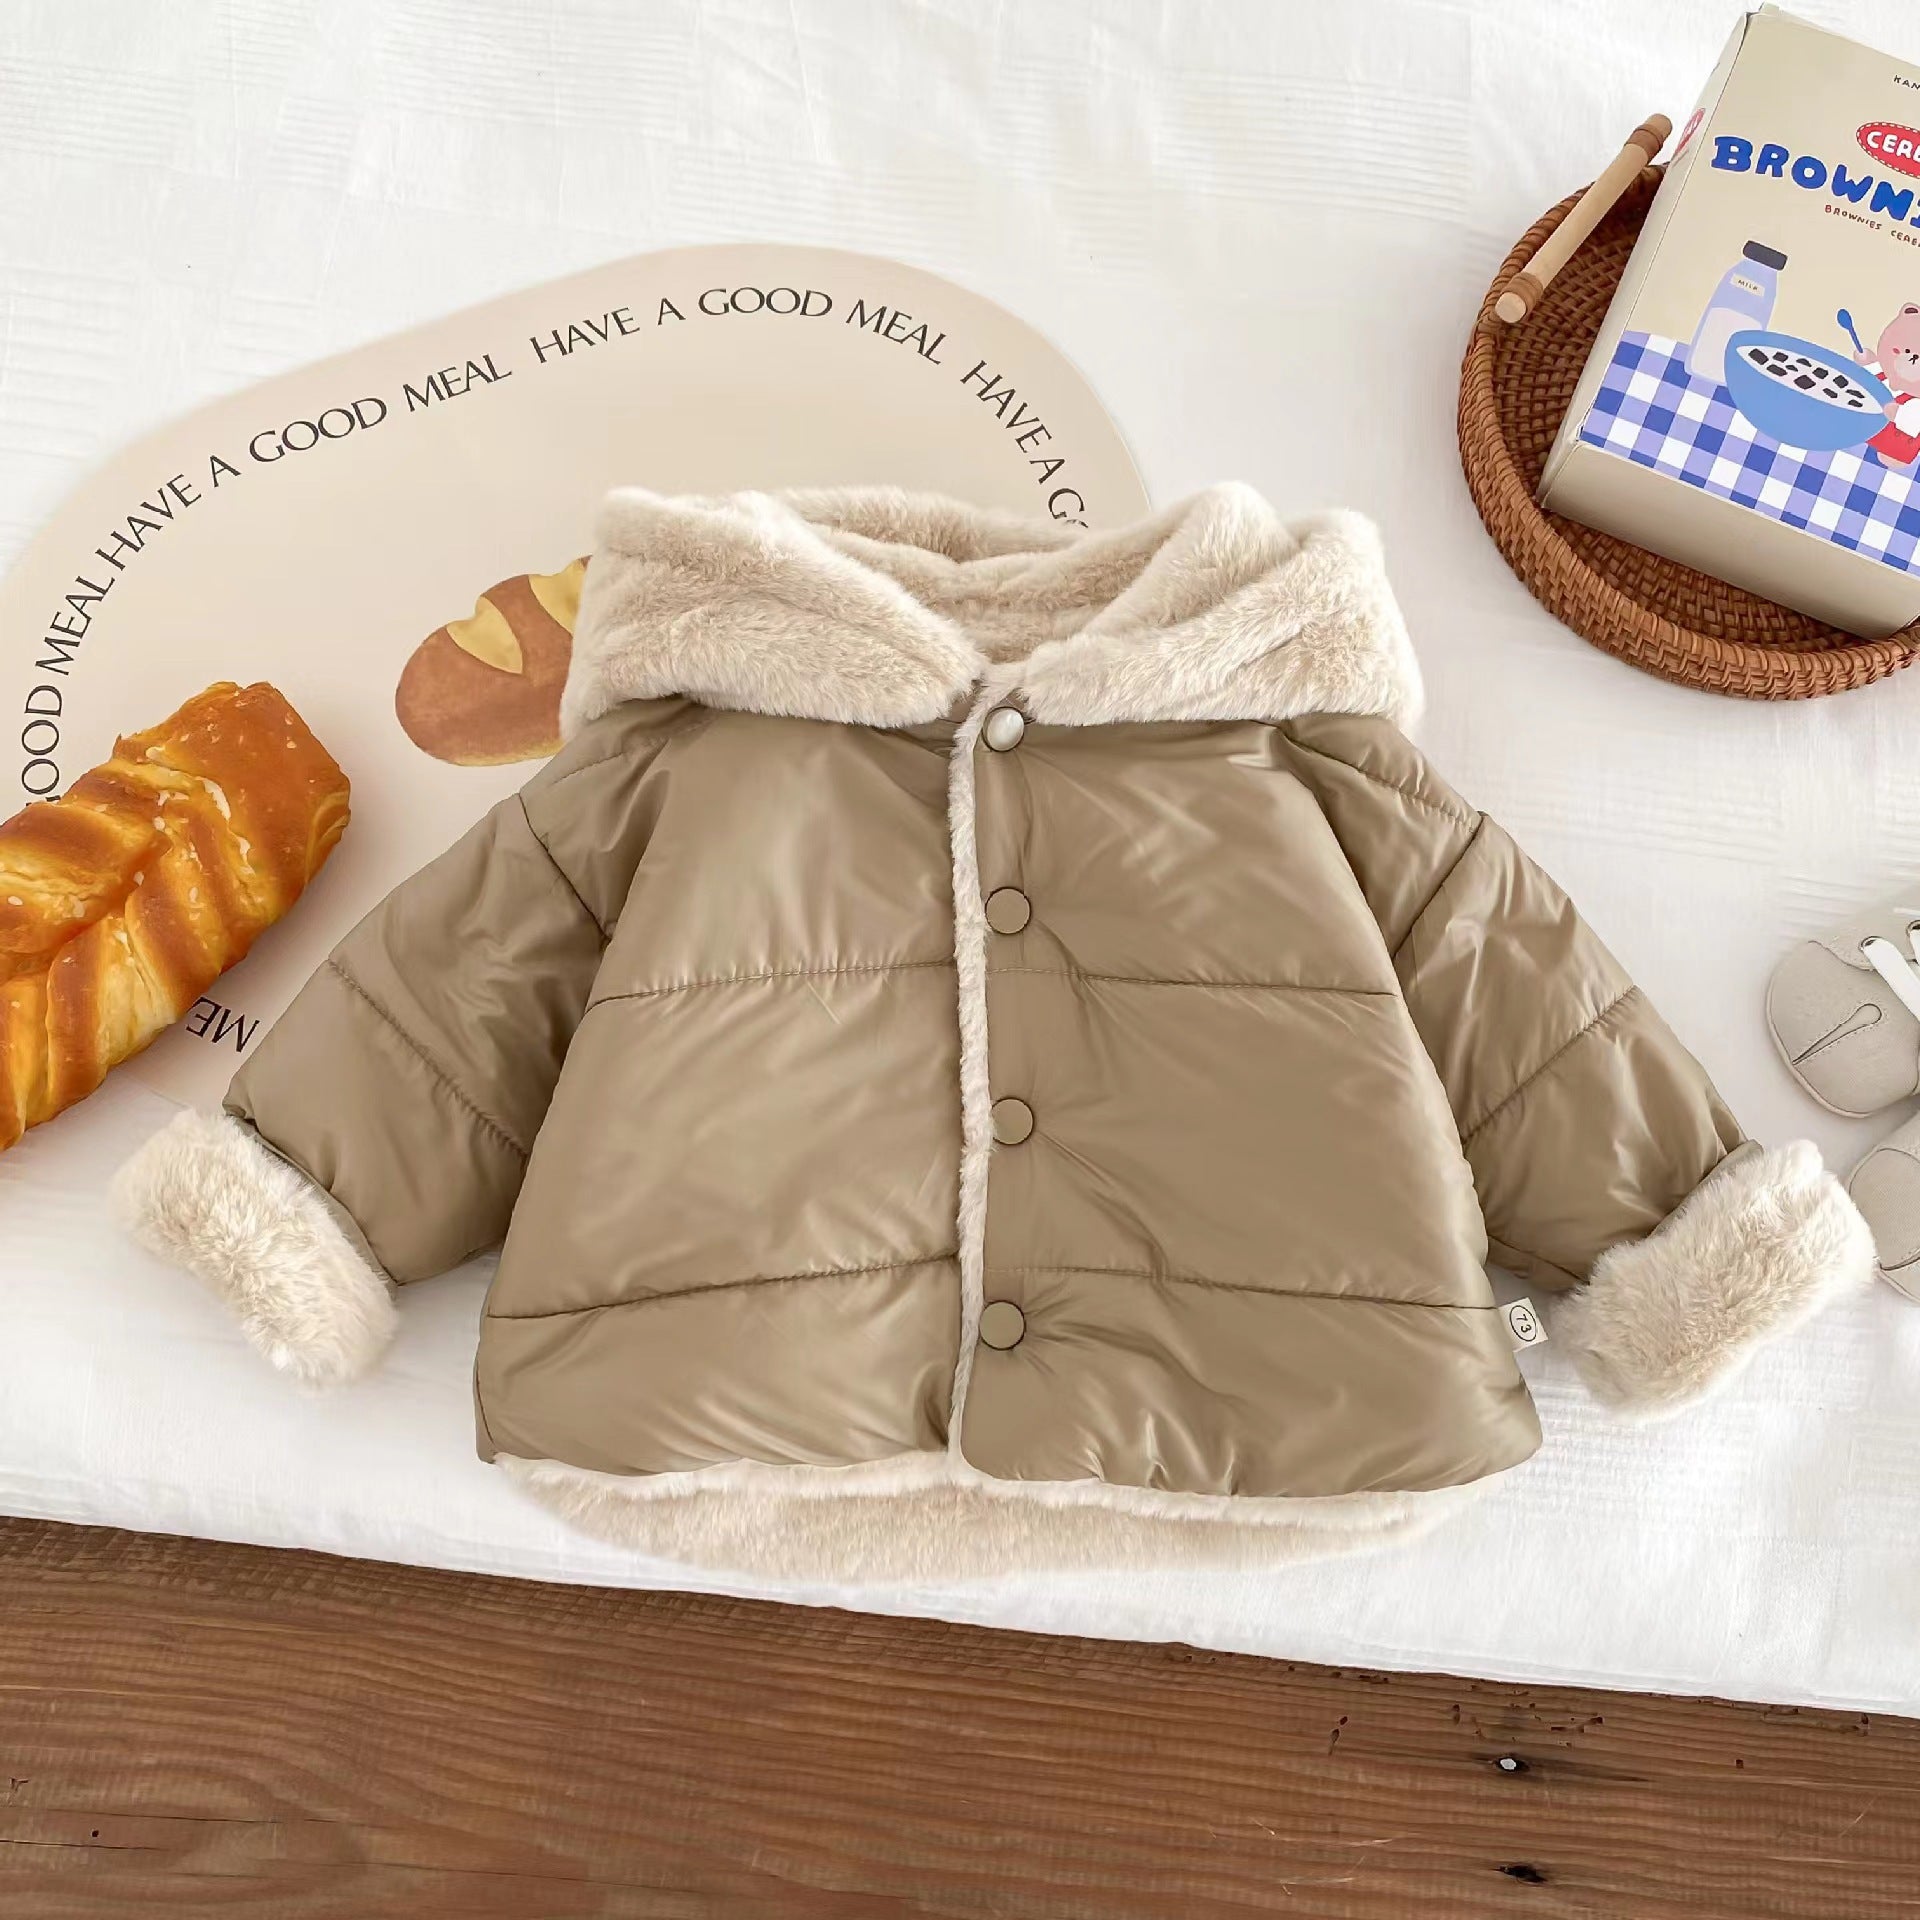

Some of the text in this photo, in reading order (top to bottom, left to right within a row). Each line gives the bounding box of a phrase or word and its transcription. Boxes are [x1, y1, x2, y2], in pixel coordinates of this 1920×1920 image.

[1825, 204, 1882, 230] BROWNIES
[658, 298, 686, 325] A
[698, 287, 833, 317] GOOD
[530, 307, 640, 364] HAVE
[846, 299, 946, 365] MEAL
[403, 354, 512, 412] MEAL
[960, 360, 1052, 453] HAVE
[249, 397, 387, 462] GOOD
[210, 455, 241, 488] A
[1029, 458, 1065, 484] A
[95, 474, 202, 571] HAVE
[36, 576, 115, 676] MEAL
[22, 685, 62, 806] OOD
